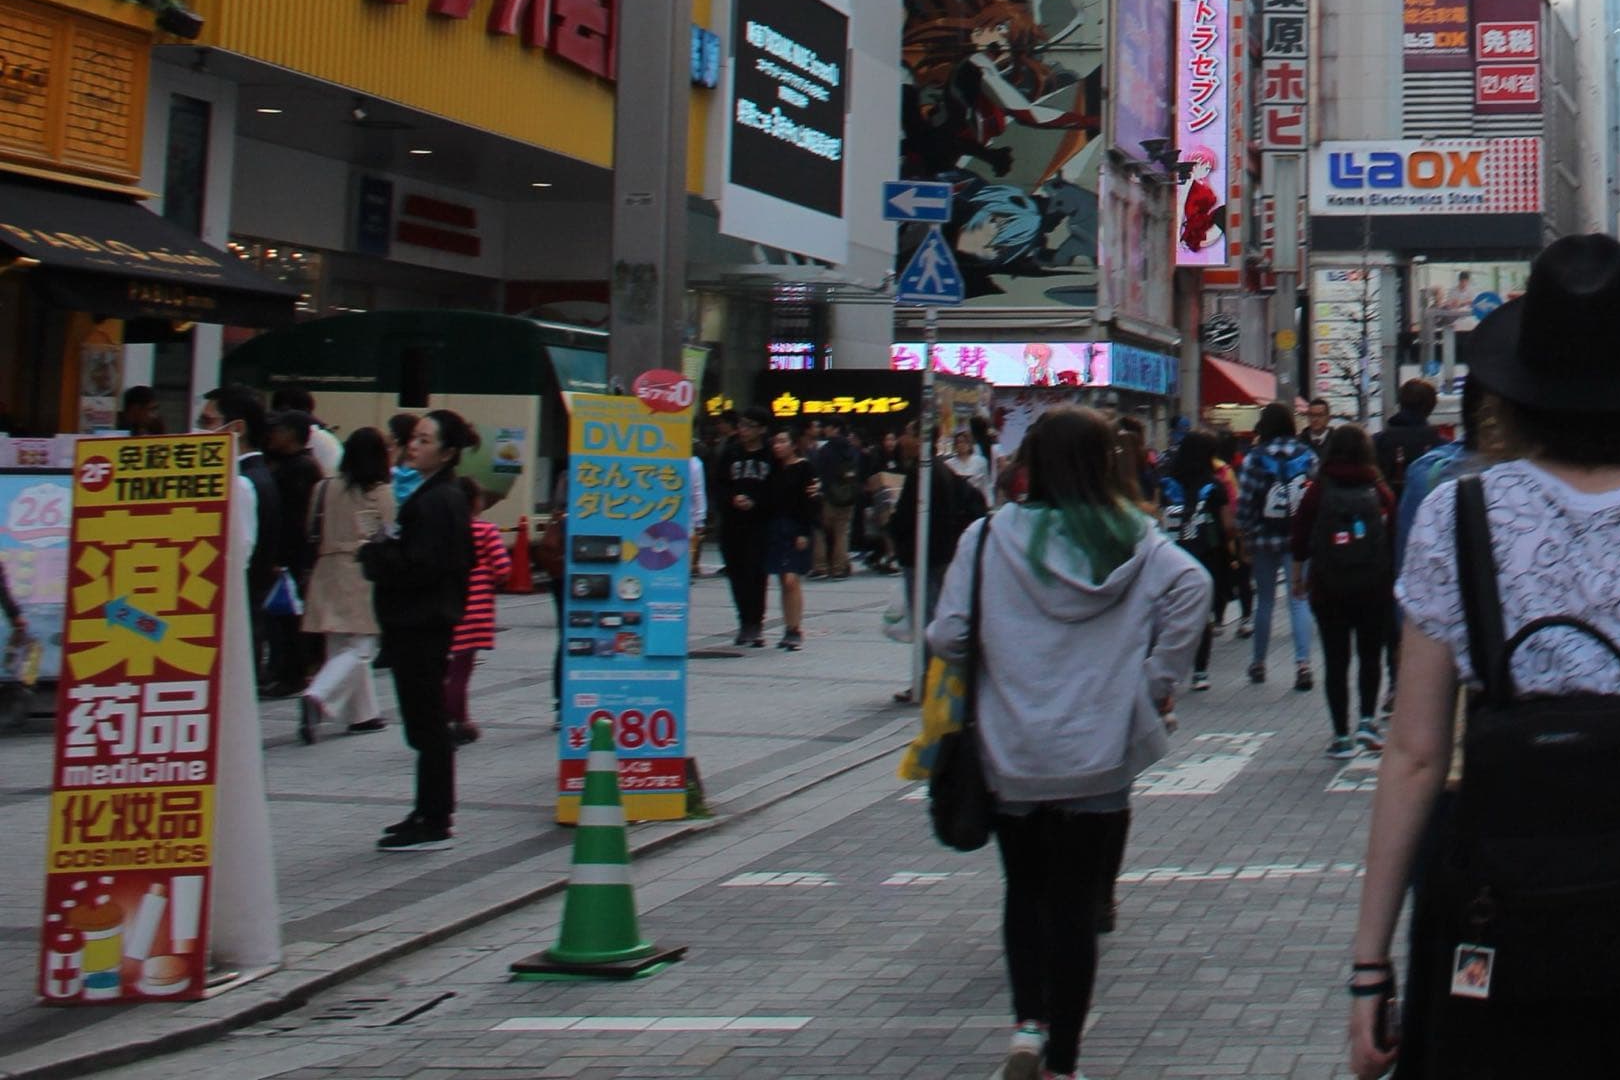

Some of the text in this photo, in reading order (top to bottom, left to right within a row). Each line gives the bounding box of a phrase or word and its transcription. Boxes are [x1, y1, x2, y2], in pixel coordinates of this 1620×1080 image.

[1327, 191, 1484, 207] Home Electronics Store
[118, 441, 226, 471] 免税专区
[80, 463, 111, 484] 2F
[576, 461, 684, 491] なんでも
[17, 495, 63, 526] 26
[576, 493, 684, 520] ダビング
[64, 680, 210, 758] 药品
[62, 757, 208, 787] medicine
[54, 842, 208, 870] cosmetics
